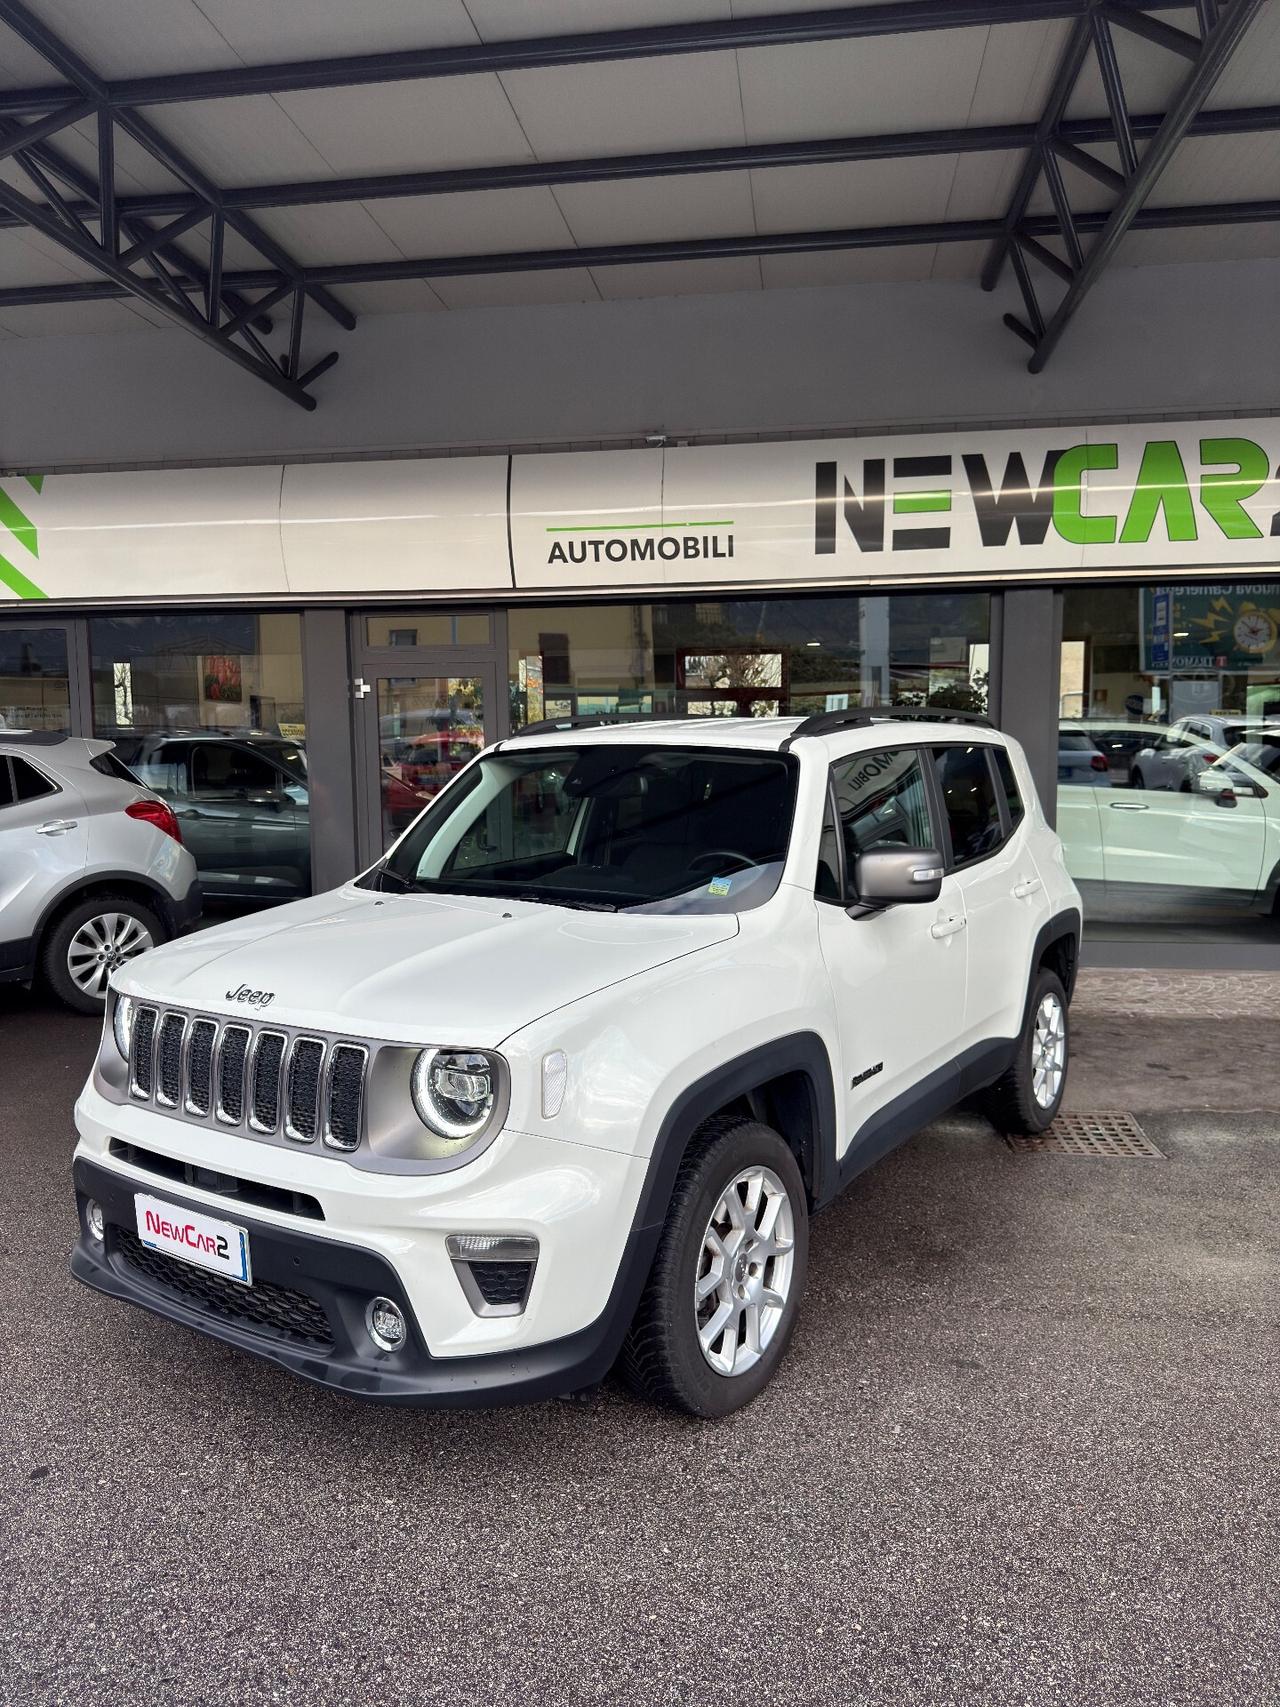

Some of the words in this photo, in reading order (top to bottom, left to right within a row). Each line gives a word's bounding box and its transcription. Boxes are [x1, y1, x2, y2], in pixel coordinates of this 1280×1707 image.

[815, 437, 1280, 554] NEWCAR
[548, 535, 734, 563] AUTOMOBILI
[225, 983, 275, 1011] Jeep
